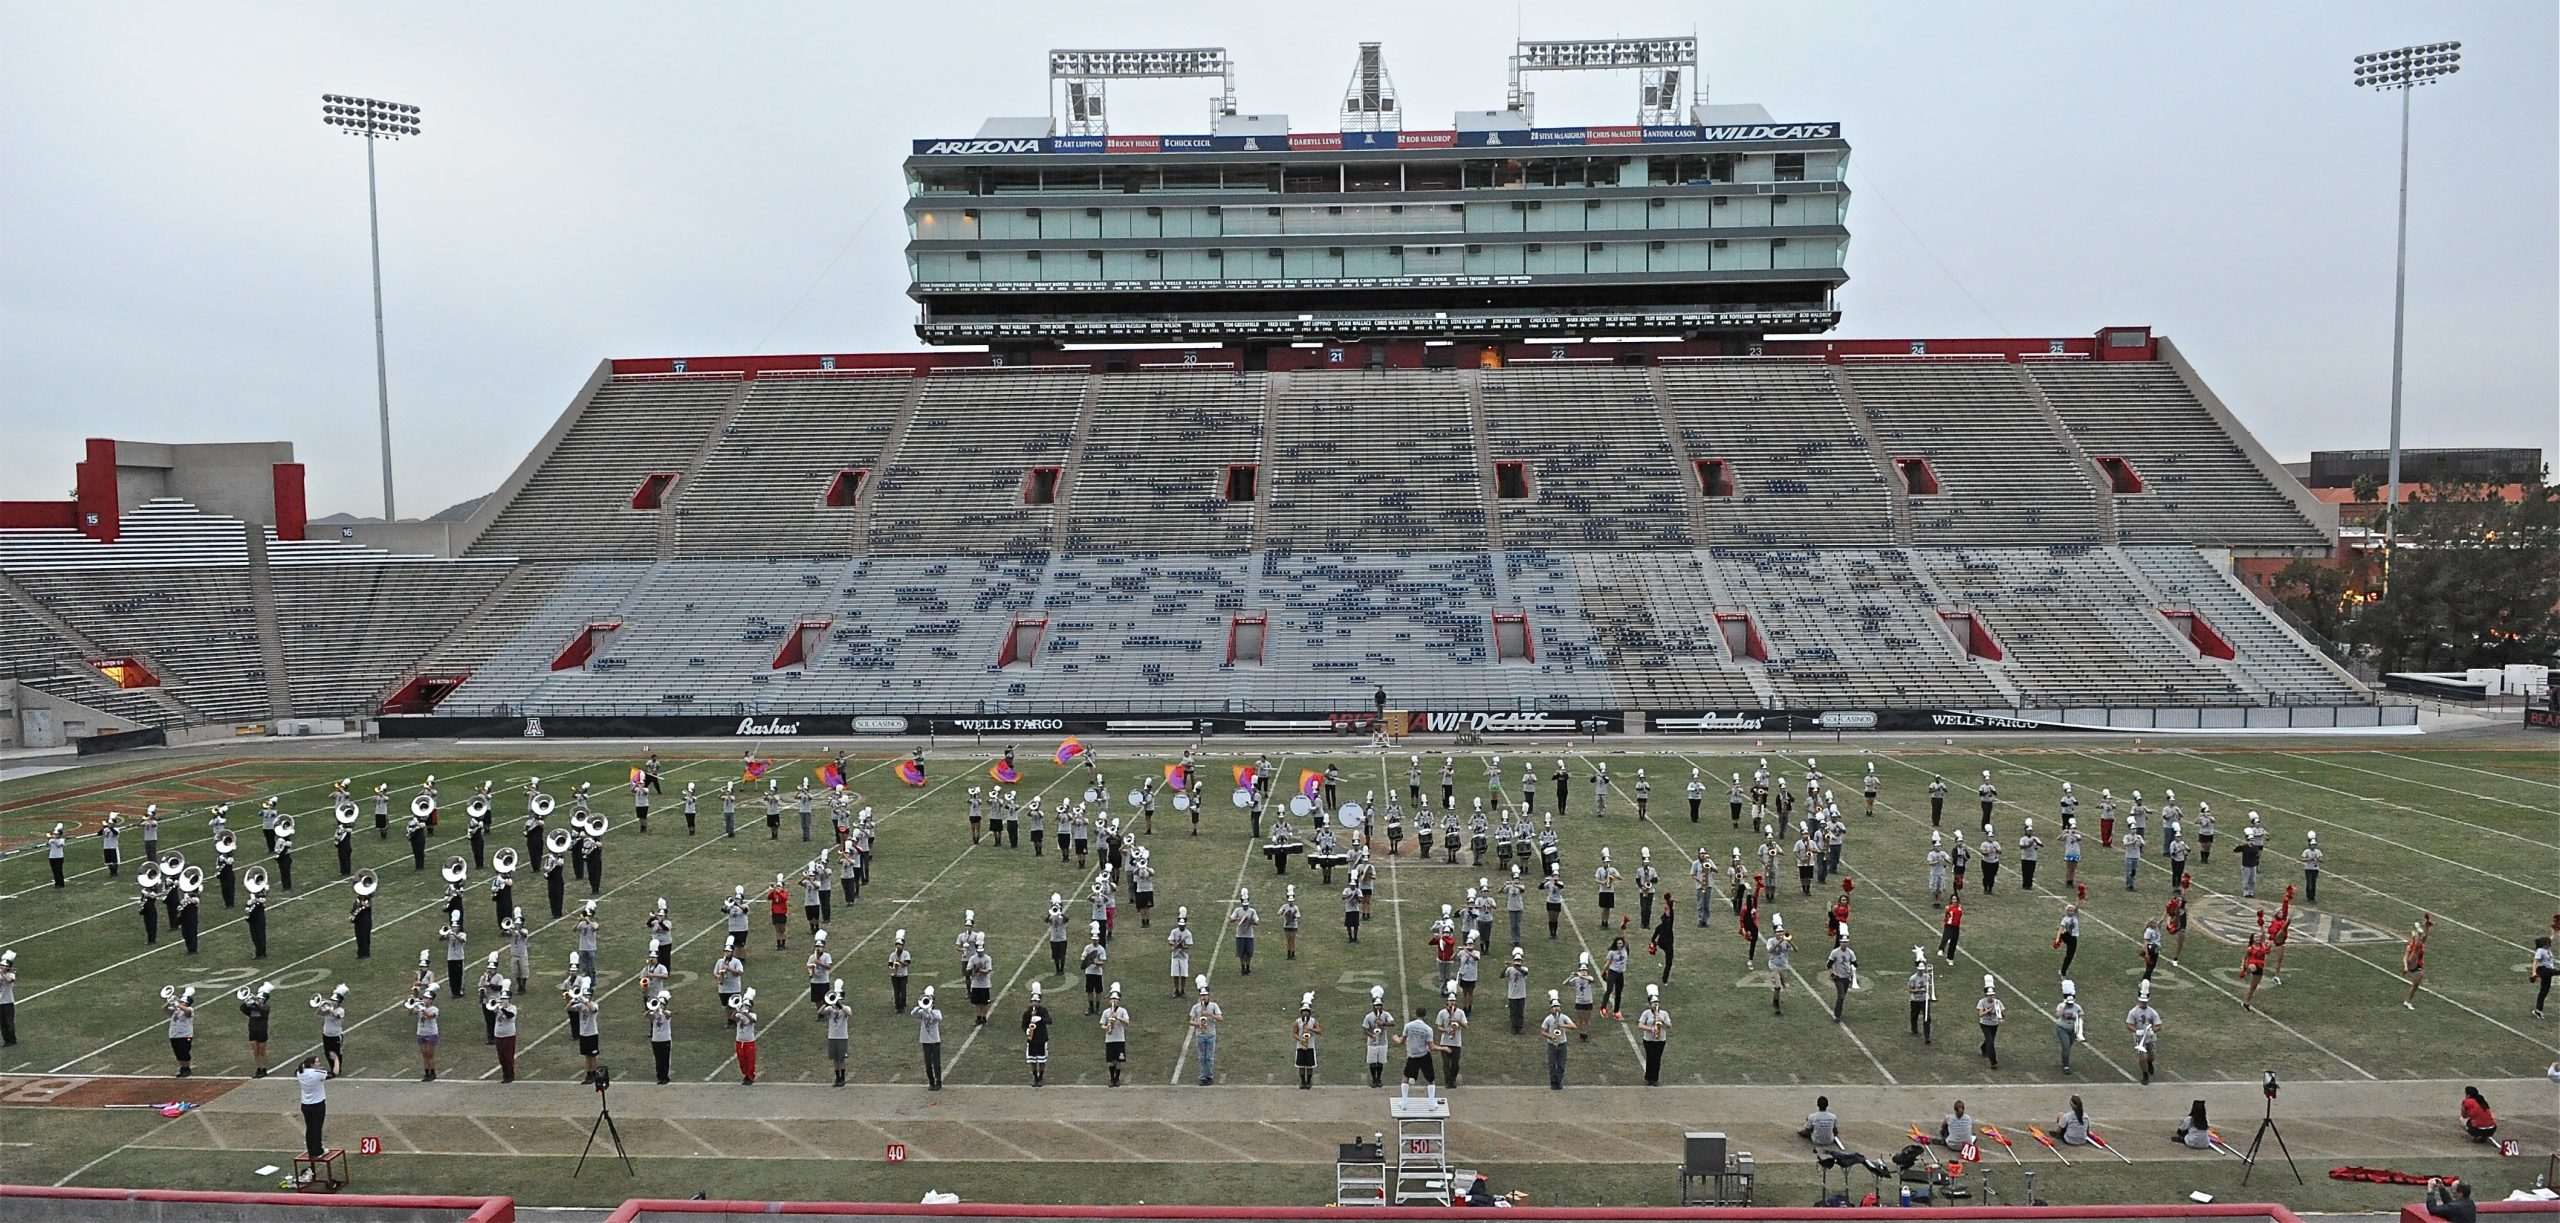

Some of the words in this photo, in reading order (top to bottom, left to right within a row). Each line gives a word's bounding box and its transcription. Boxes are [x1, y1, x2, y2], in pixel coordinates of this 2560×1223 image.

[1613, 130, 1641, 138] McALISTER
[1648, 130, 1674, 138] ANTOINE
[1705, 126, 1833, 140] WILDCATS
[1054, 140, 1062, 148] 22
[1062, 140, 1074, 148] ART
[1075, 140, 1103, 148] LUPPINO
[1193, 139, 1211, 147] CECIL
[1288, 138, 1293, 146] 4
[1294, 138, 1321, 146] DARRYLL
[926, 140, 1039, 154] ARIZONA
[1552, 350, 1564, 359] 22
[1749, 347, 1762, 356] 23
[1912, 346, 1924, 355] 24
[2051, 346, 2063, 354] 25
[991, 358, 1003, 366] 19
[1184, 355, 1197, 364] 20
[1331, 353, 1342, 362] 21
[675, 365, 685, 373] 17
[823, 361, 834, 370] 18
[87, 516, 98, 524] 15
[343, 528, 353, 536] 16
[1840, 715, 1872, 723] CASINOS
[1932, 715, 1984, 725] WELLS
[736, 717, 799, 735] Bashas'
[871, 720, 902, 728] CASINOS
[961, 720, 1011, 730] WELLS
[1014, 719, 1062, 729] FARGO
[362, 1138, 377, 1154] 30
[1413, 1140, 1428, 1154] 50
[2504, 1141, 2519, 1156] 30
[889, 1146, 903, 1161] 40
[1962, 1144, 1976, 1161] 40
